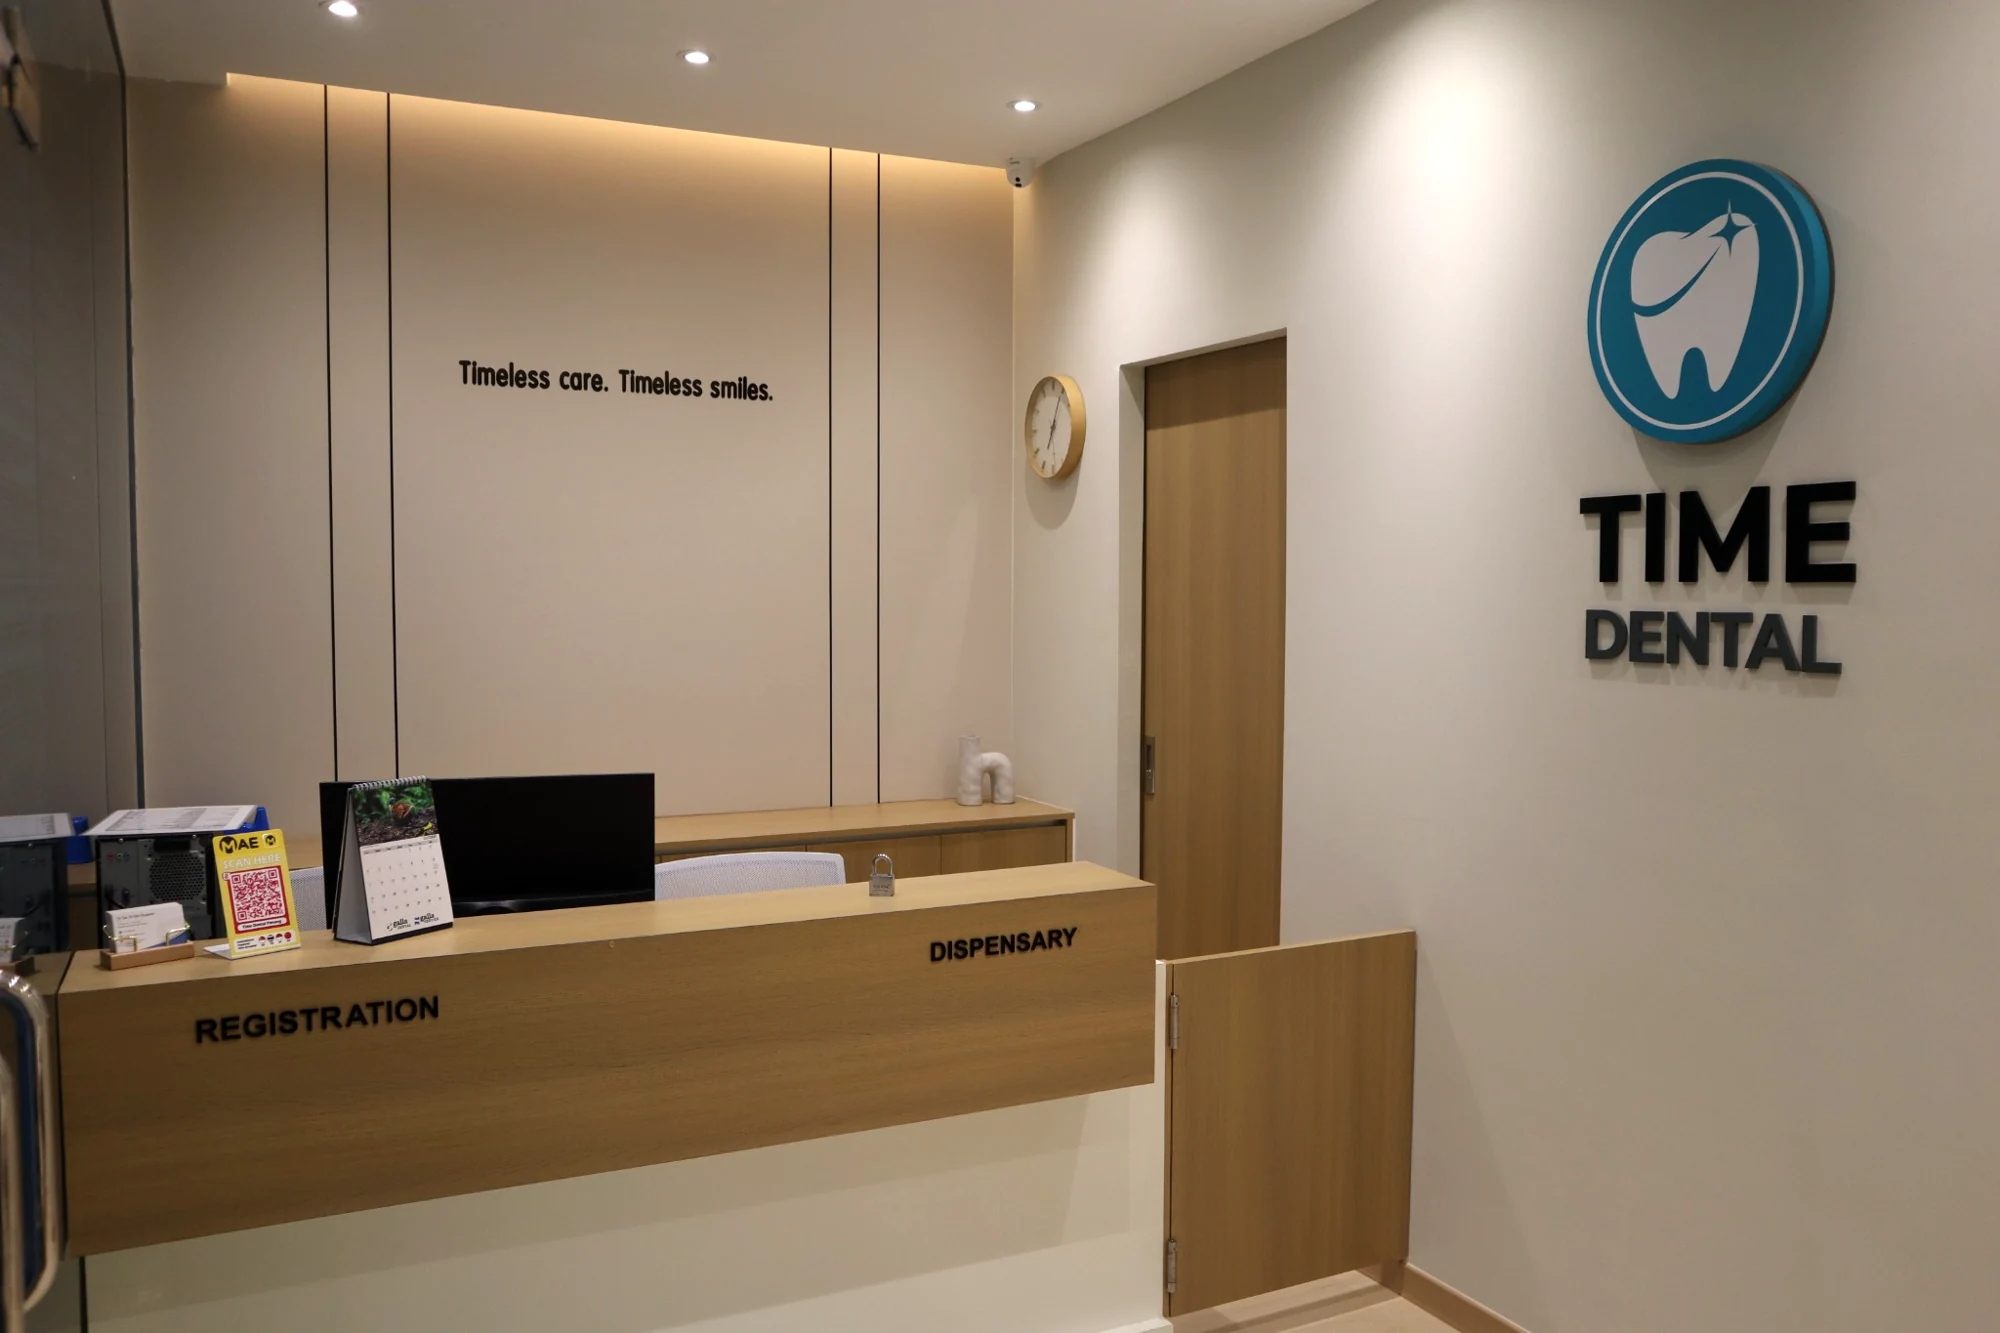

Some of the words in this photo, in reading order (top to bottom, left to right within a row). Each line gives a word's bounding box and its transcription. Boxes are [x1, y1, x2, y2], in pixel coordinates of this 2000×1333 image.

[458, 359, 551, 390] Timeless
[558, 369, 609, 393] care.
[618, 368, 703, 397] Timeless
[709, 375, 774, 401] smiles.
[1579, 480, 1857, 583] TIME
[1585, 608, 1843, 675] DENTAL
[219, 836, 259, 854] MAE
[223, 857, 251, 869] SCAN
[253, 853, 281, 865] HERE
[930, 927, 1078, 962] DISPENSARY
[195, 995, 440, 1044] REGISTRATION
